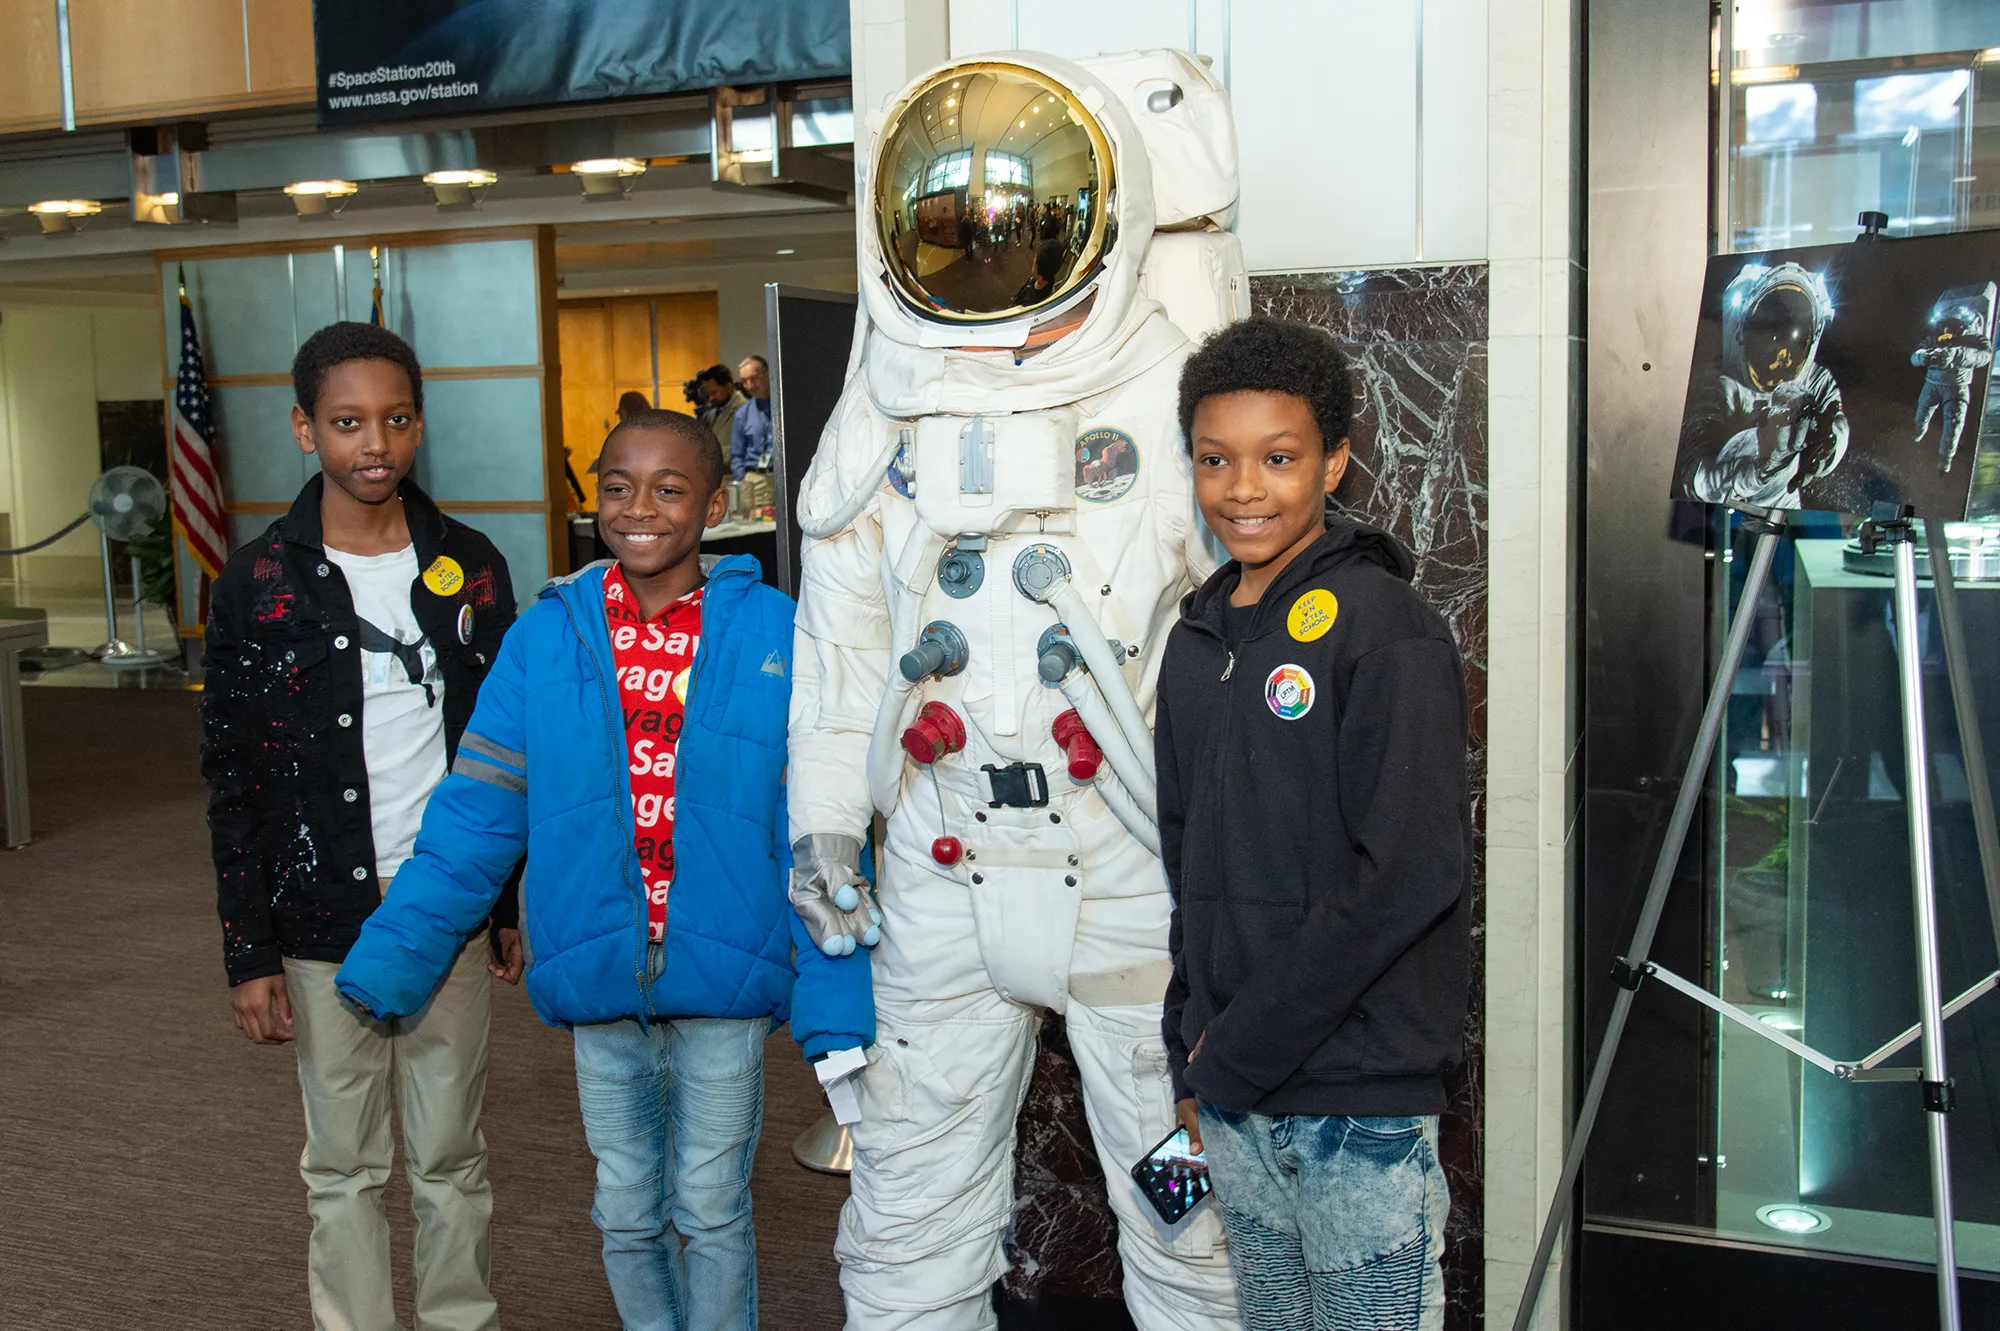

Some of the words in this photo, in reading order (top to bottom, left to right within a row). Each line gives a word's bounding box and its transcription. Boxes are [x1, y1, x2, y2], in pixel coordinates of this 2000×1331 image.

[328, 60, 456, 90] #SpaceStation20th
[328, 81, 478, 110] www.nasa.gov/station
[1080, 432, 1110, 447] APOLLO
[441, 575, 461, 592] SCHOOL
[1298, 595, 1316, 610] KEEP
[1299, 614, 1330, 636] SCHOOL
[1300, 609, 1324, 627] AFTER
